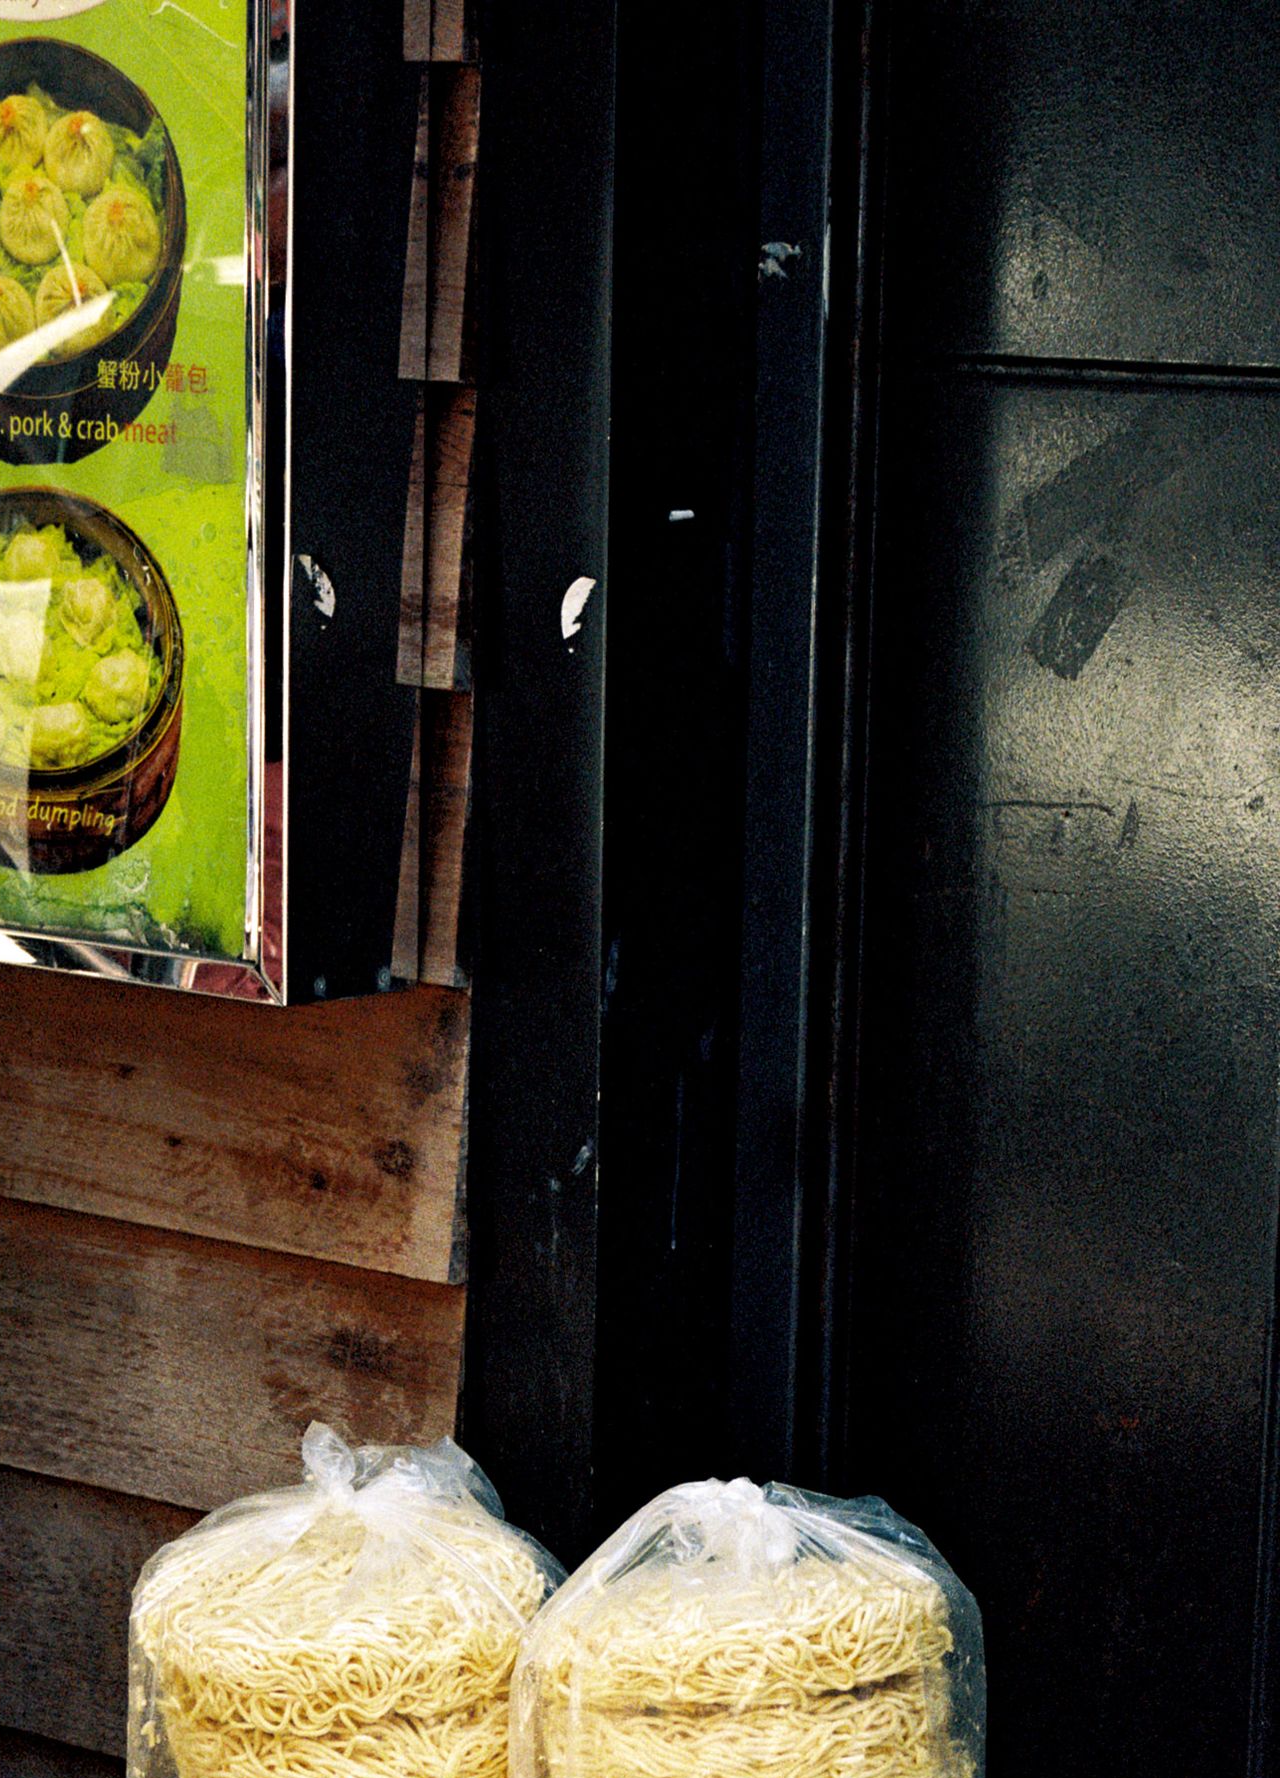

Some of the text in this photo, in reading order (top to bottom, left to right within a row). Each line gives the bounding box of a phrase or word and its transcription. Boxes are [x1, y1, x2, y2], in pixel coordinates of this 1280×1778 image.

[9, 410, 53, 441] pork
[58, 411, 73, 440] &
[77, 413, 120, 442] crab
[27, 795, 118, 837] dumpling
